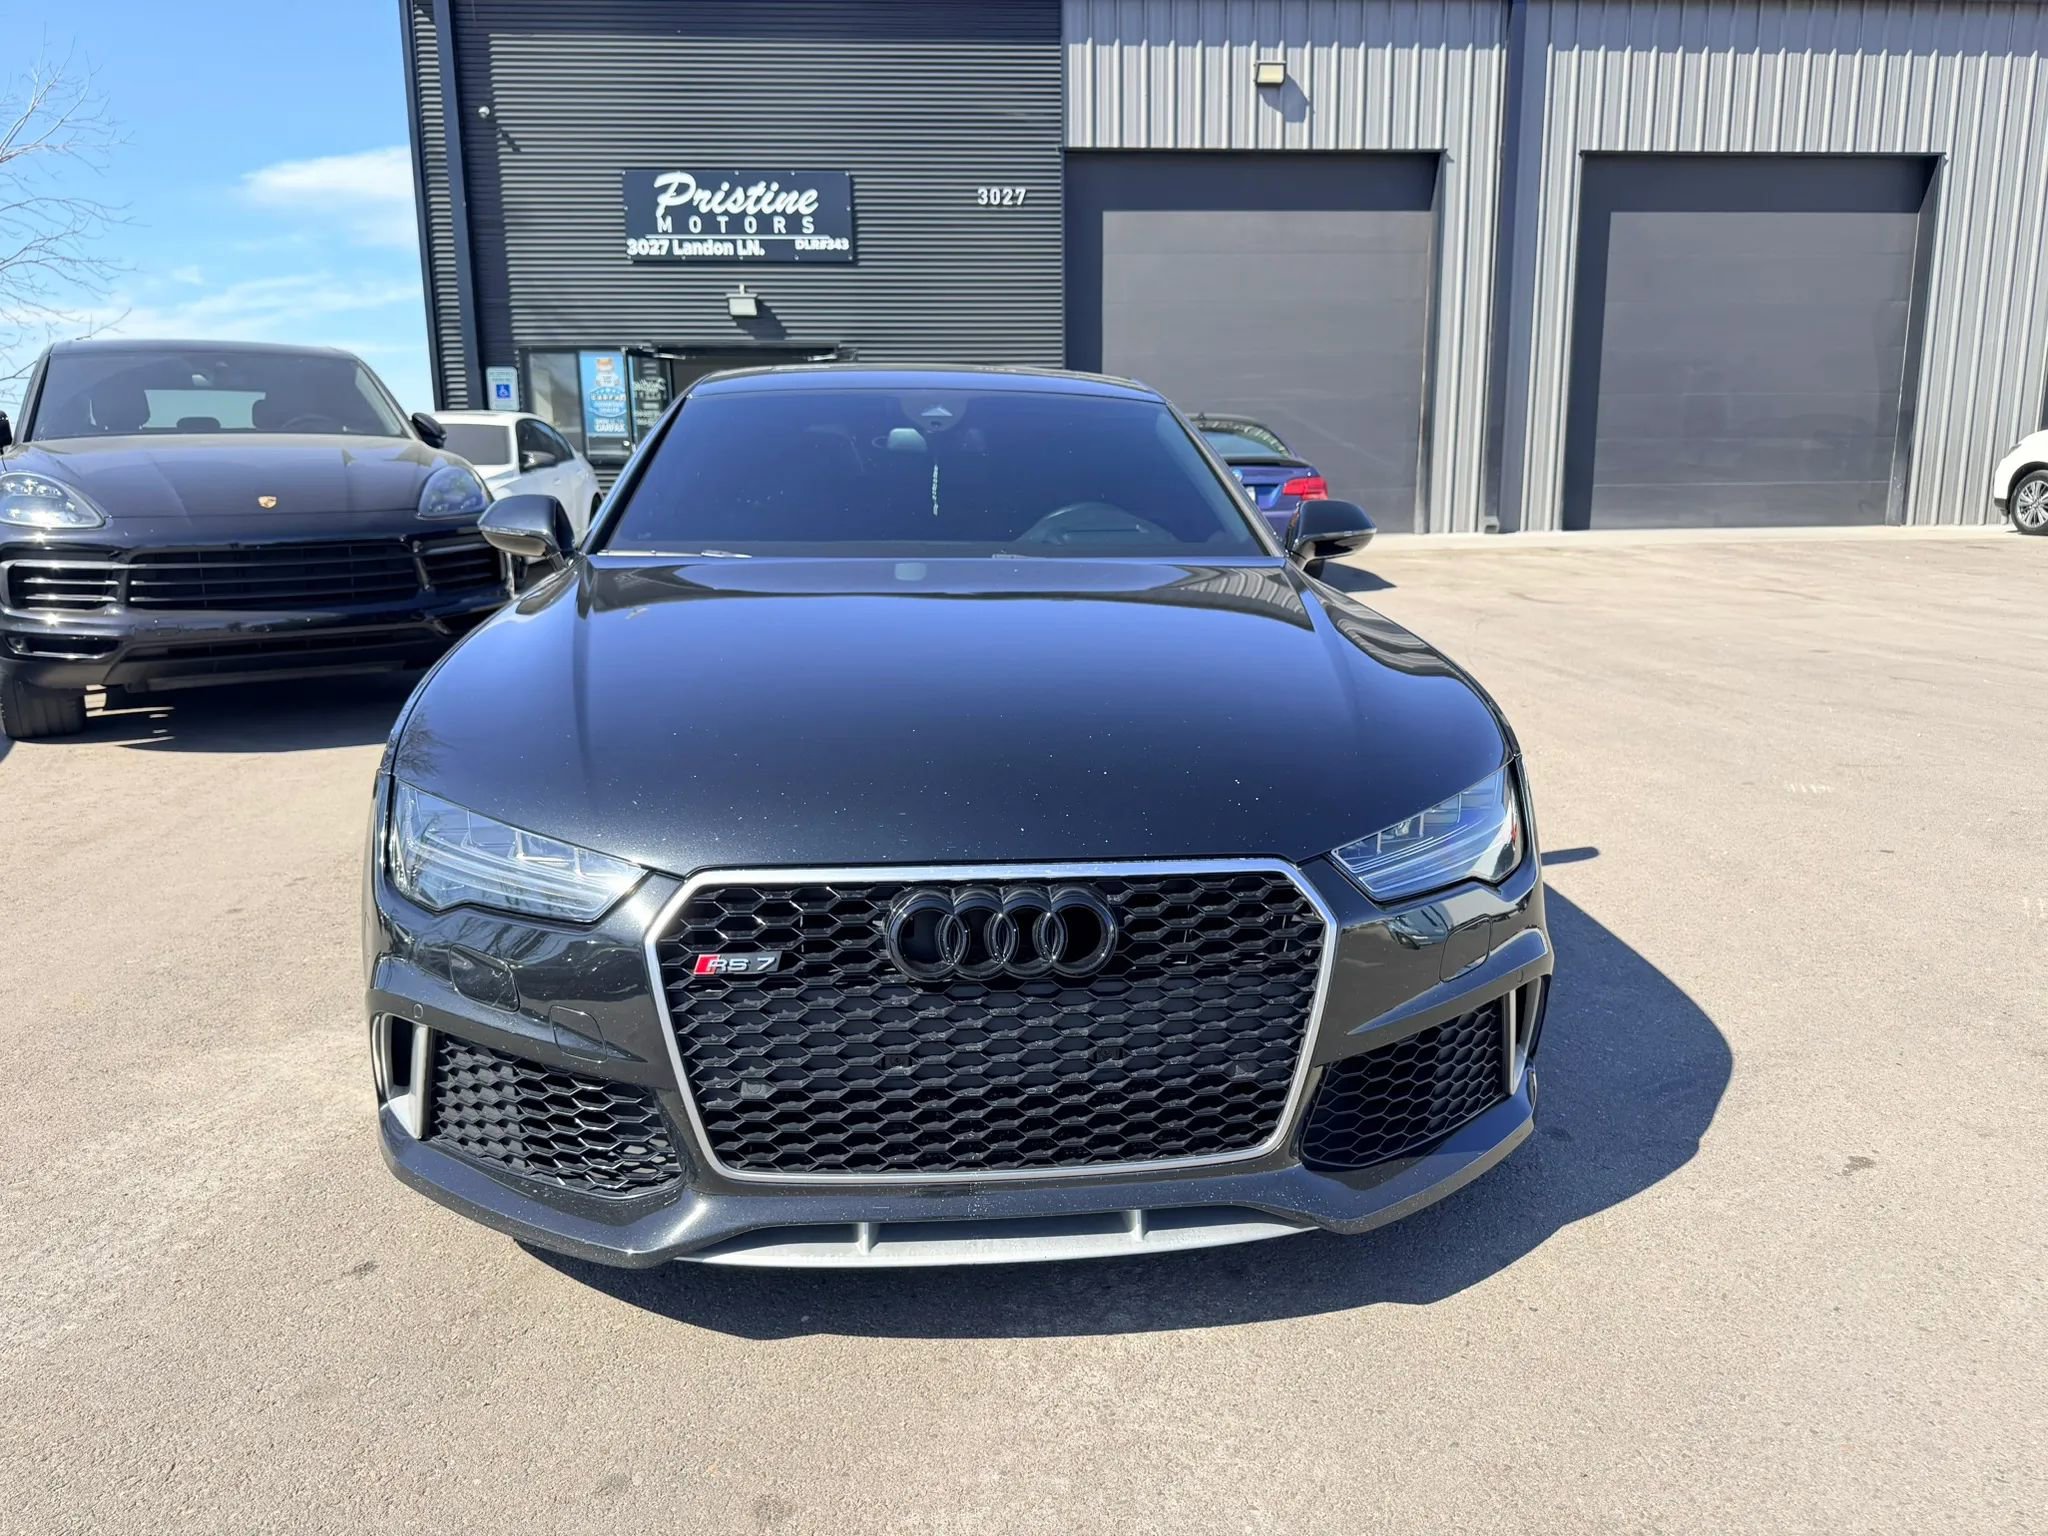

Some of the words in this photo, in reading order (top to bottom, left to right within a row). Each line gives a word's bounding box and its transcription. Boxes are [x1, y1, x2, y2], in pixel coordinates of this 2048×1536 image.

[654, 171, 819, 217] Pristine
[977, 186, 1026, 205] 3027
[657, 216, 815, 234] MOTORS
[626, 238, 669, 256] 3027
[672, 239, 735, 256] Landon
[736, 239, 766, 256] LN.
[708, 958, 749, 972] RS
[757, 956, 777, 971] 7
